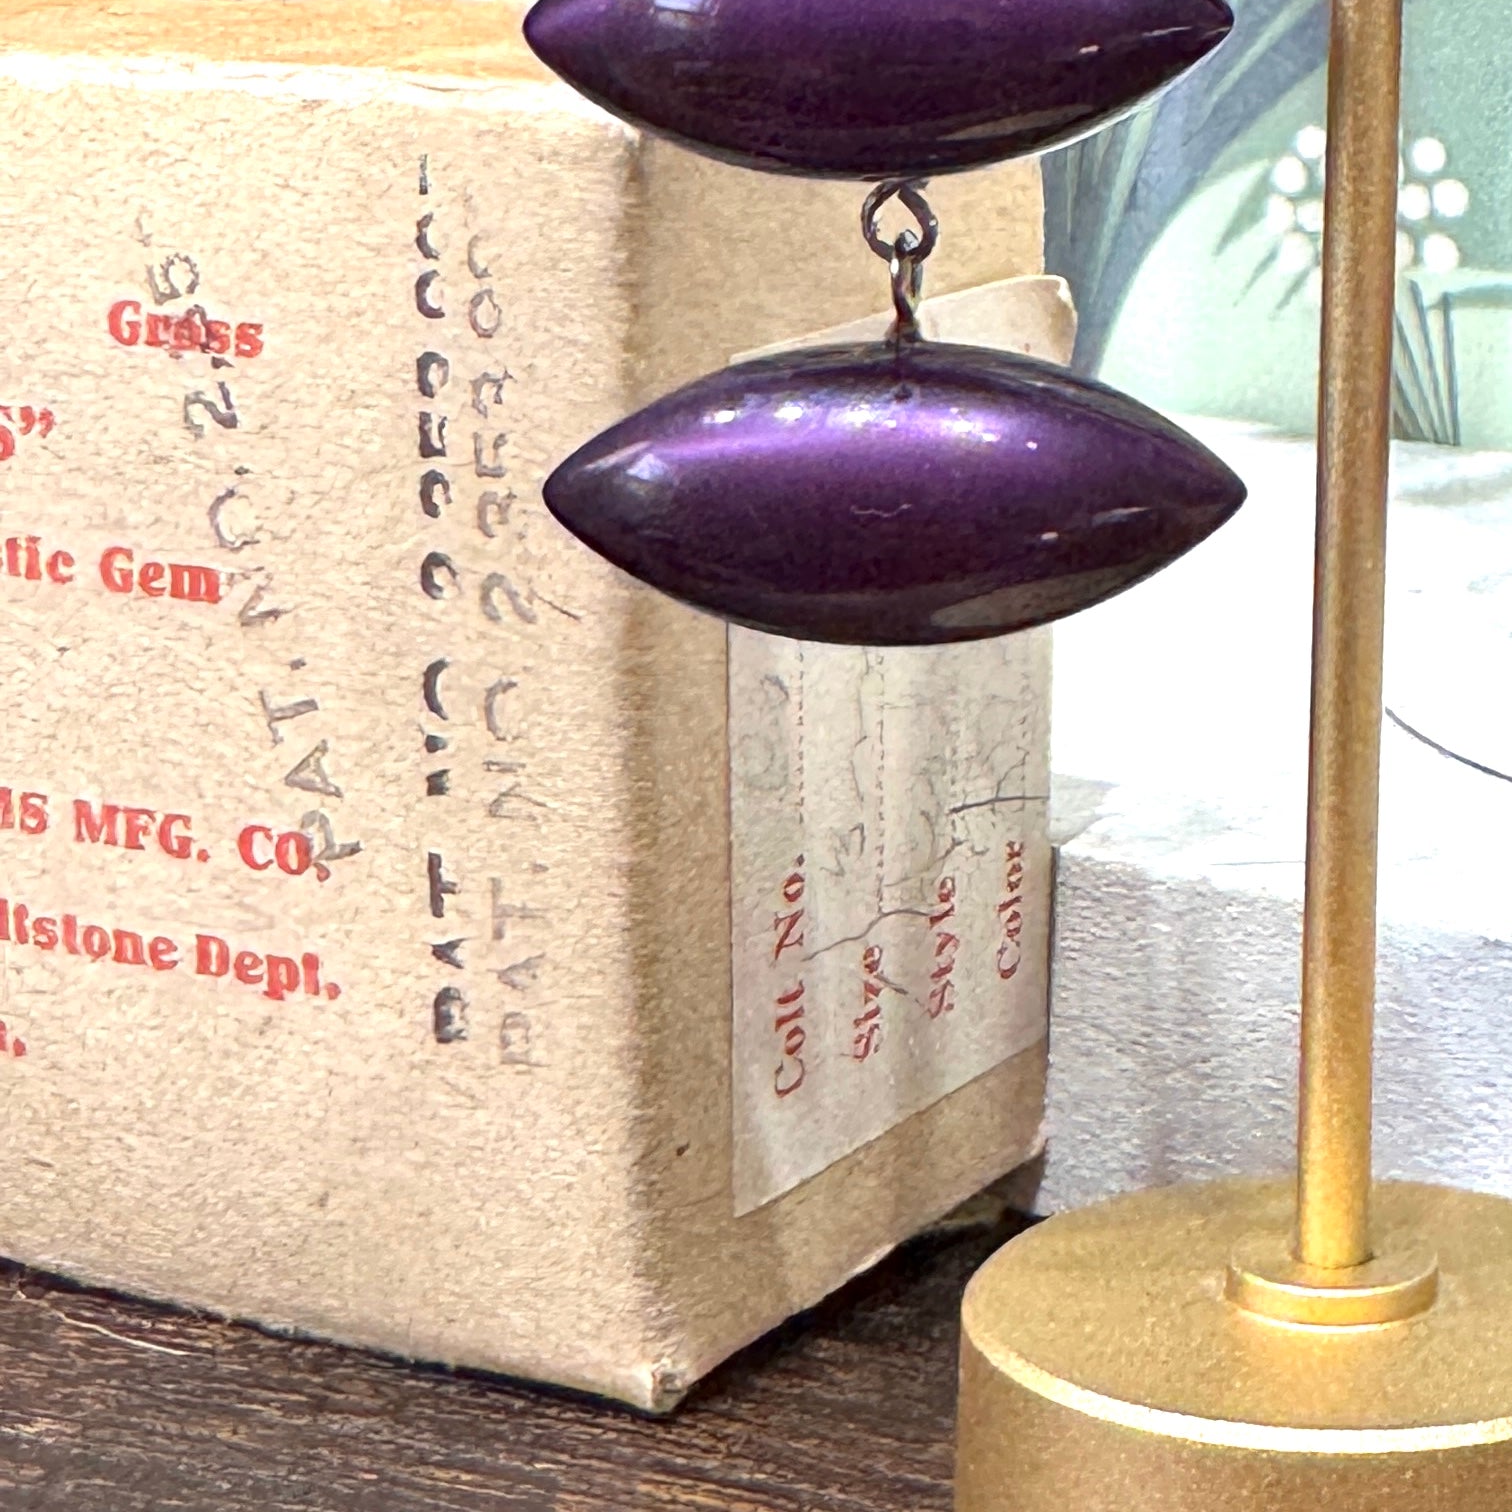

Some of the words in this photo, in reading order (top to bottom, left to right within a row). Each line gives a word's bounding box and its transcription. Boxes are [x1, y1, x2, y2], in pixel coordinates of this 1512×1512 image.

[0, 535, 76, 584] tic
[100, 545, 223, 604] Gem
[73, 799, 210, 862] MFG.
[773, 854, 806, 963] No.
[928, 875, 960, 1019] Style
[998, 839, 1025, 979] Color
[195, 933, 341, 1000] Dept.
[852, 945, 884, 1062] Size
